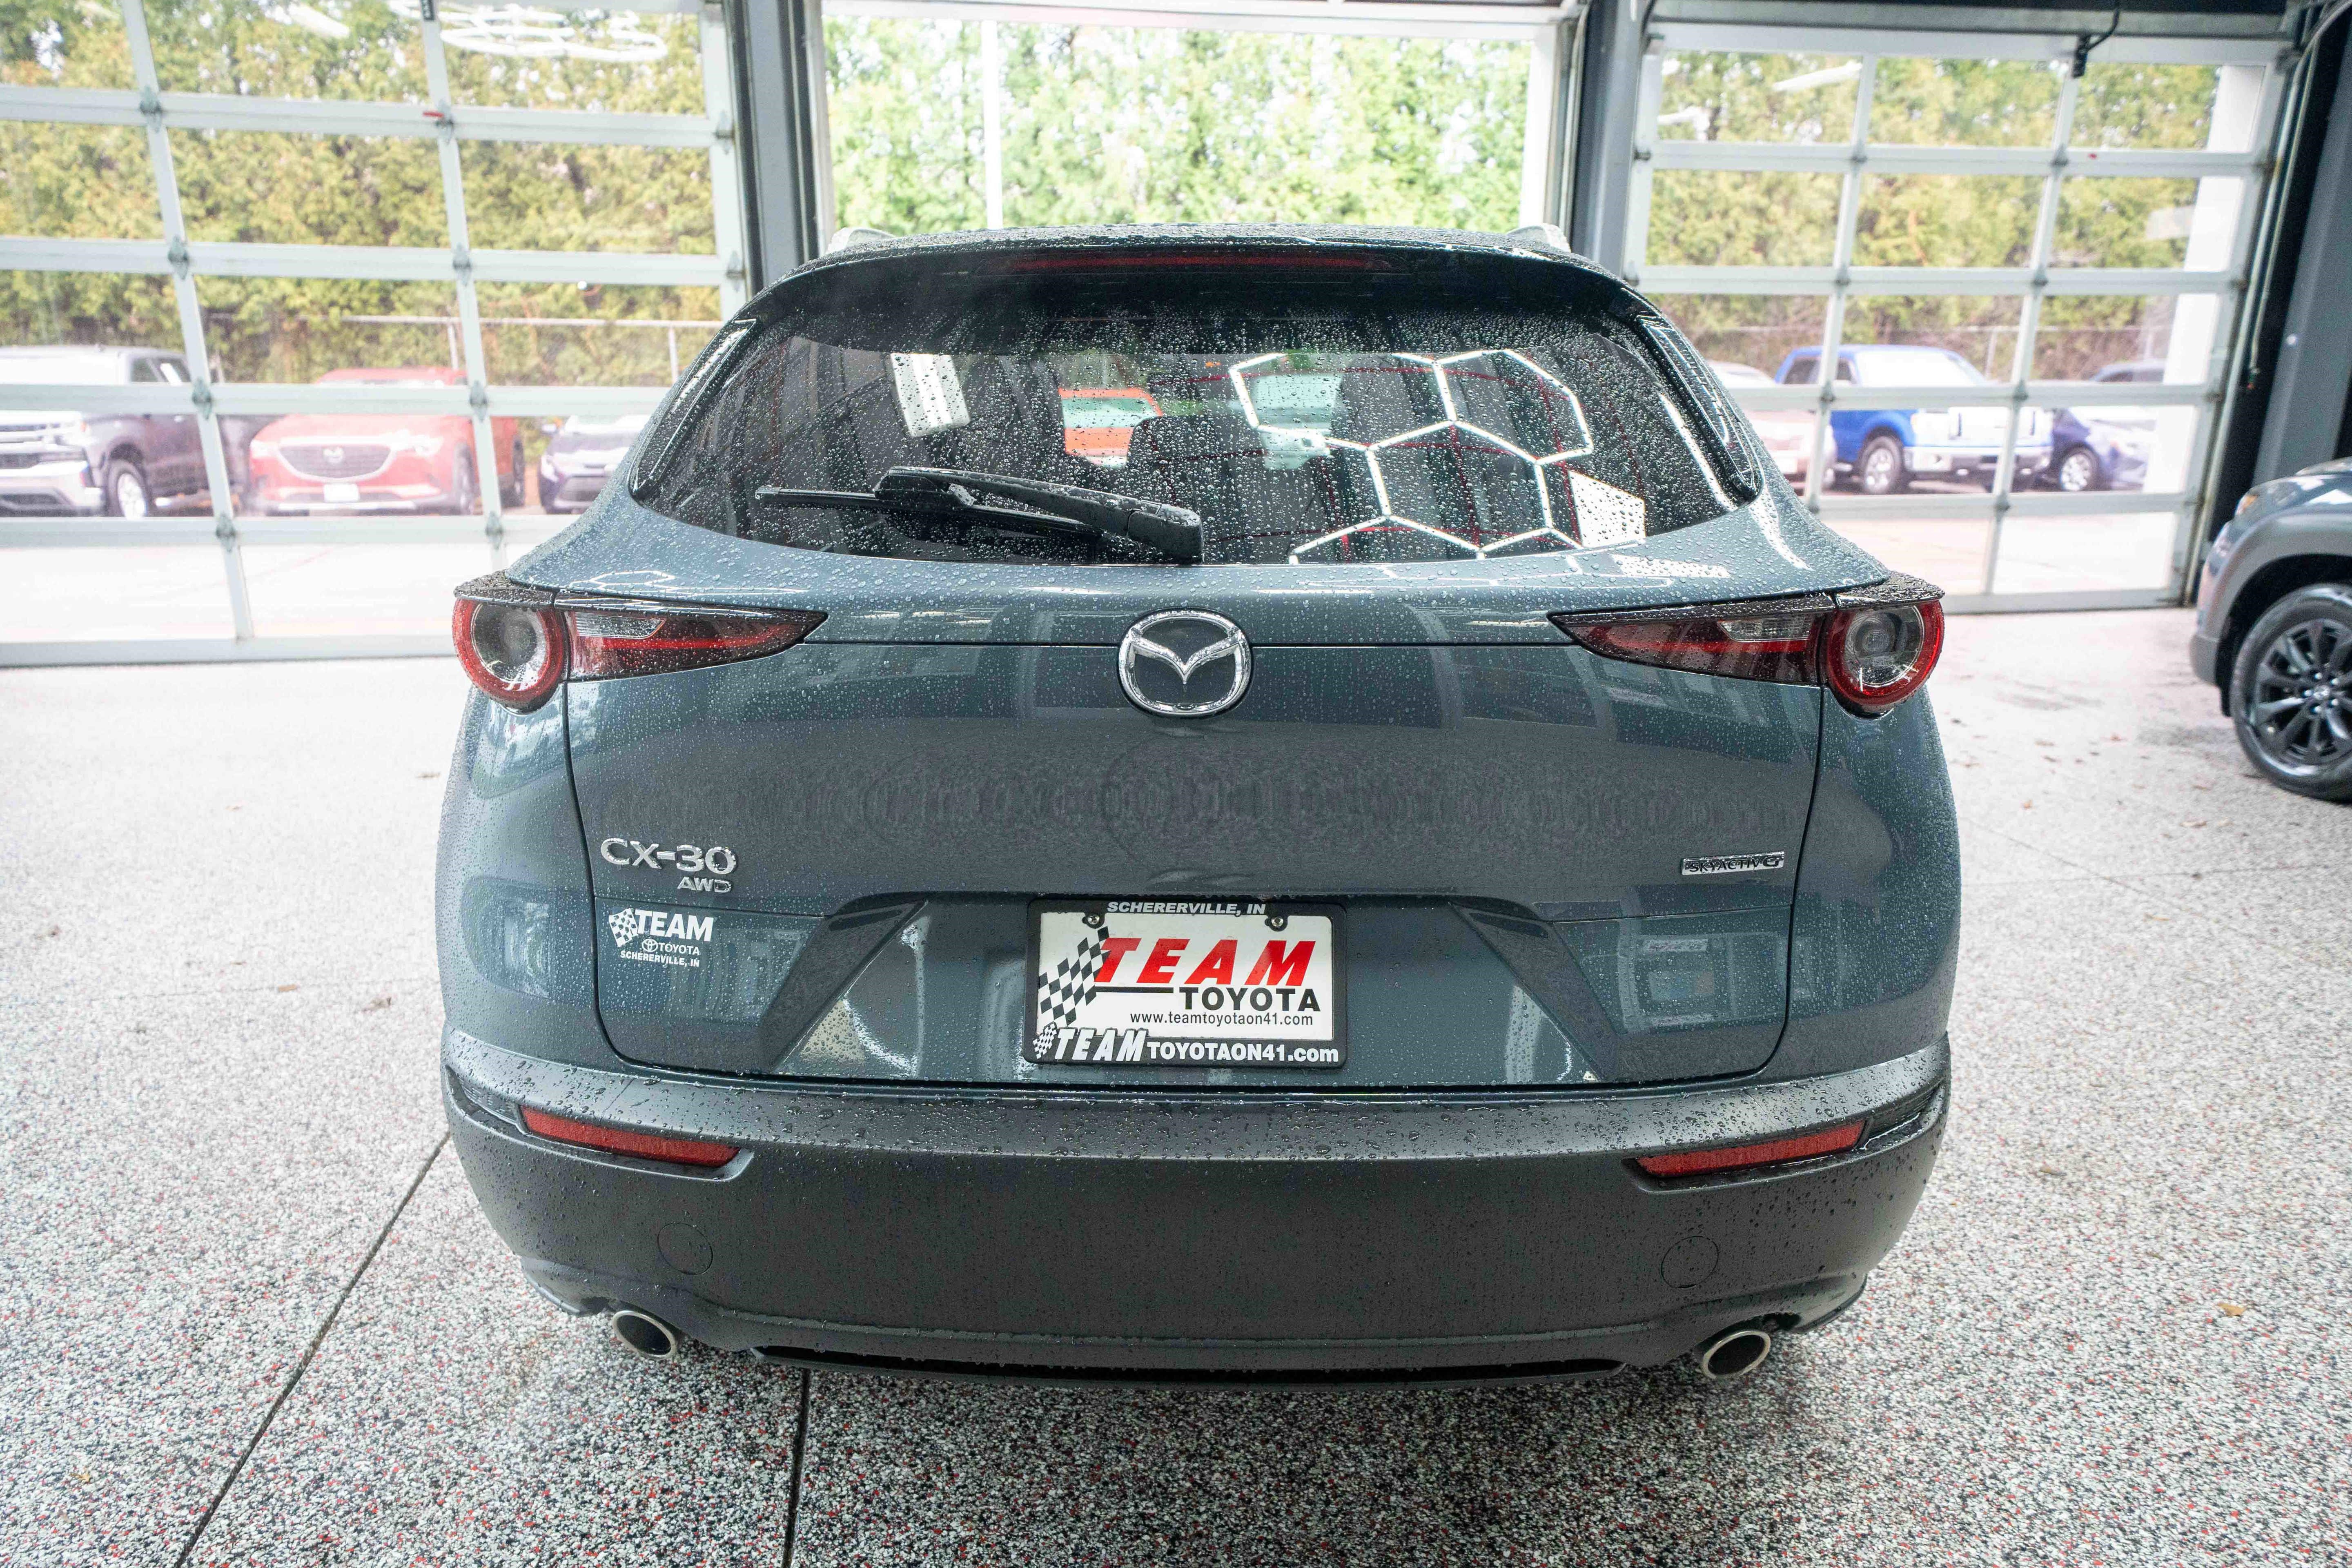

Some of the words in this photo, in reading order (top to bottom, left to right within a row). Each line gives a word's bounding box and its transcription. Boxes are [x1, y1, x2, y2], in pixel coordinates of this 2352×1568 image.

[600, 837, 736, 875] CX-30
[677, 876, 732, 893] AWD
[1107, 901, 1241, 916] SCHERERVILLE,
[1247, 904, 1265, 915] IN
[634, 908, 714, 941] TEAM
[620, 950, 688, 967] SCHERERVILLE,
[690, 958, 700, 967] IN
[658, 942, 700, 956] TOYOTA
[1094, 937, 1316, 986] TEAM
[1179, 987, 1321, 1012] TOYOTA
[1130, 1011, 1314, 1027] www.teamtoyotaon41.com
[1056, 1028, 1147, 1062] TEAM
[1147, 1041, 1339, 1062] TOYOTAON41.com
